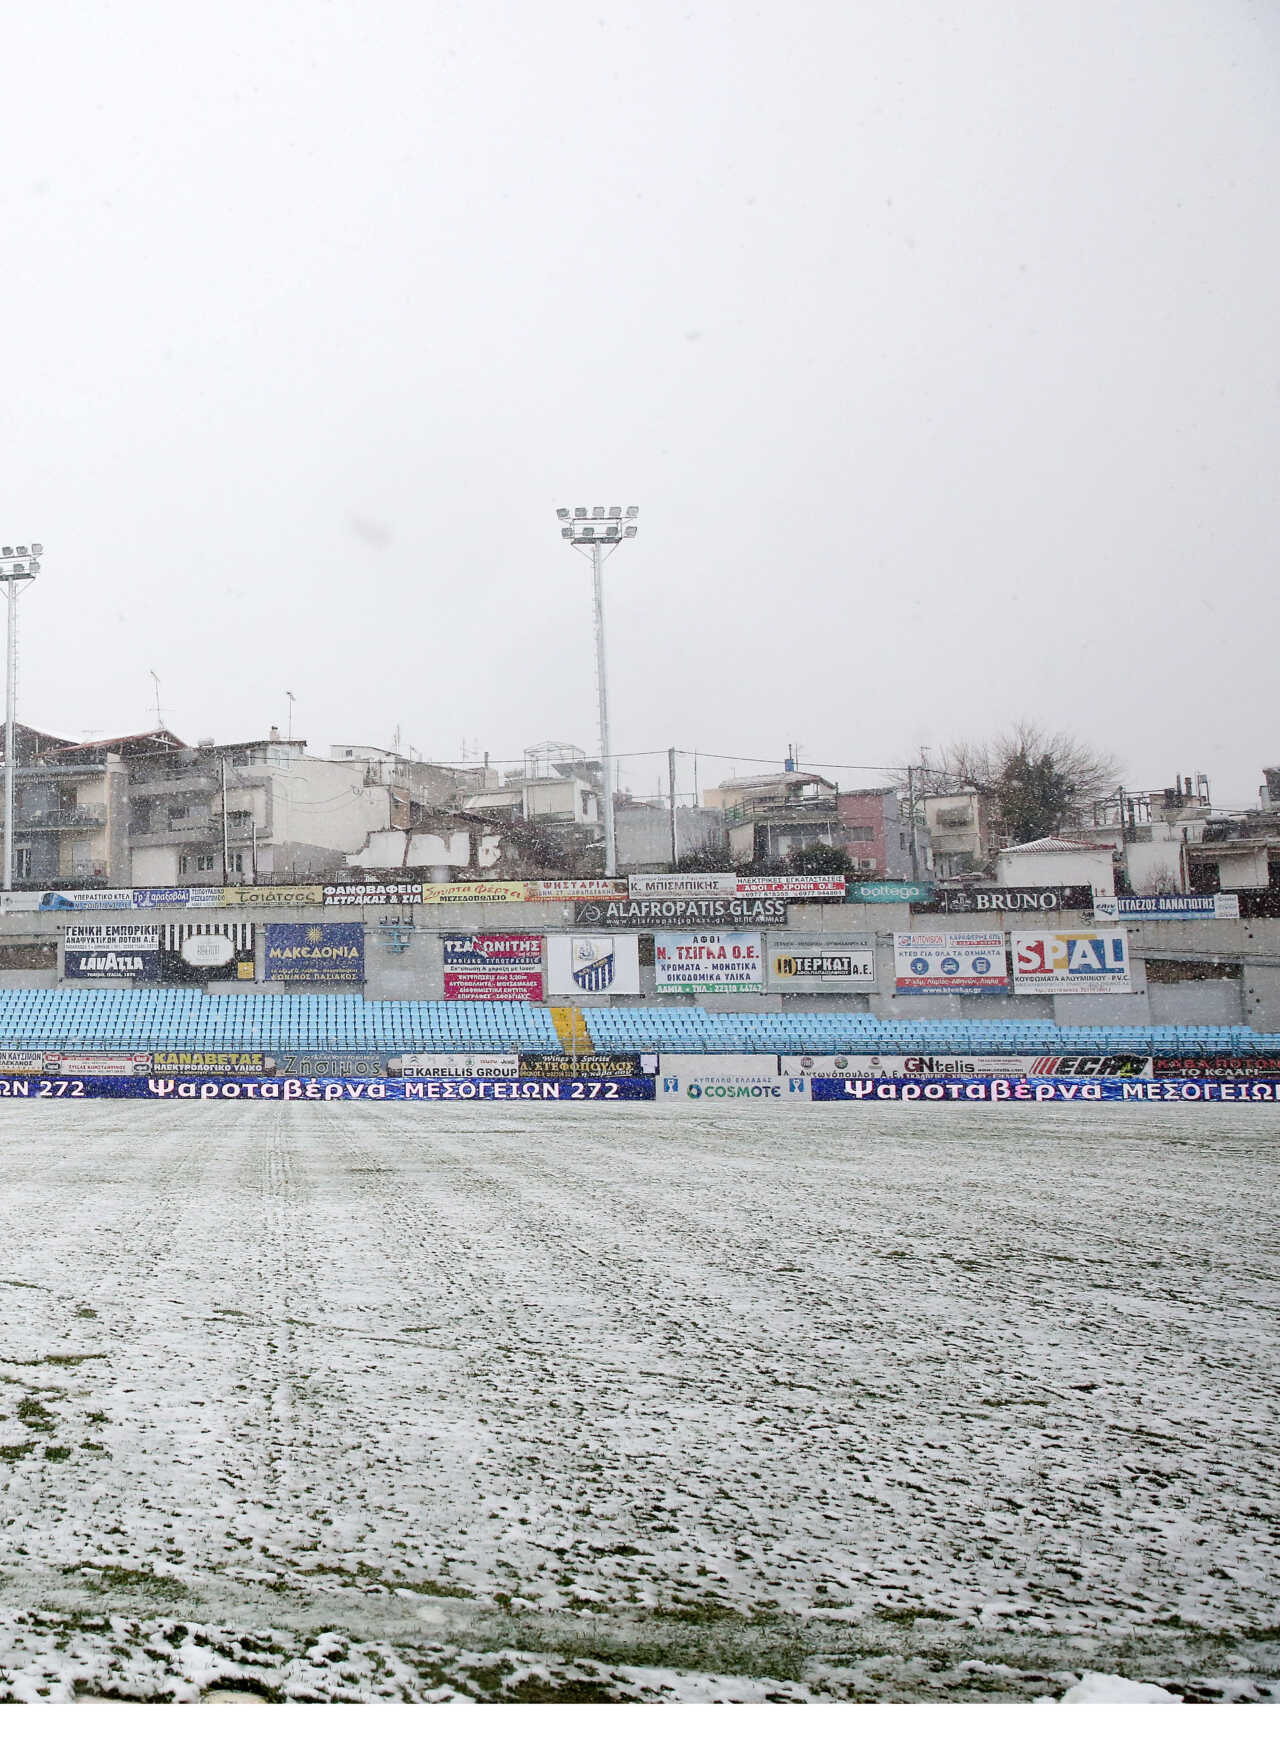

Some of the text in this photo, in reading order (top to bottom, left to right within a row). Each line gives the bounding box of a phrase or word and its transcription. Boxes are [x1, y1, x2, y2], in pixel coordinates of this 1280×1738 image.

[323, 884, 422, 894] ΦΑΝΟΒΑΦΕΙΟ
[543, 881, 609, 889] ΨΗΣΤΑΡΙΑ
[324, 894, 422, 905] ΑΣΤΡΑΚΑΣ & ΣΙΑ
[976, 893, 1057, 910] BRUNO
[607, 900, 785, 917] ALAFROPATIS GLASS
[66, 925, 158, 937] ΓΕΝΙΚΗ ΕΜΠΟΡΙΚΗ
[692, 935, 721, 944] ΑΦΟΙ
[269, 947, 360, 959] ΜΑΚΕΔΟΝΙΑ
[732, 945, 760, 959] Ο.Ε.
[1017, 936, 1125, 974] SPAL
[80, 952, 144, 971] LAVAZZA
[660, 962, 701, 971] ΧΡΩΜΑΤΑ
[852, 964, 872, 975] Α.Ε.
[667, 972, 751, 982] ΟΙΚΟΔΟΜΙΚΑ ΥΛΙΚΑ
[153, 1053, 263, 1065] ΚΑΝΑΒΕΤΑΣ
[284, 1055, 382, 1075] Ζήσιμος
[416, 1067, 474, 1077] KARELLIS
[477, 1067, 518, 1077] GROUP
[39, 1080, 86, 1097] 272
[148, 1079, 620, 1100] Ψαροταβέρνα ΜΕΣΟΓΕΙΩΝ 272
[705, 1085, 782, 1099] COSMOTE
[844, 1079, 1103, 1101] Ψαροταβέρνα
